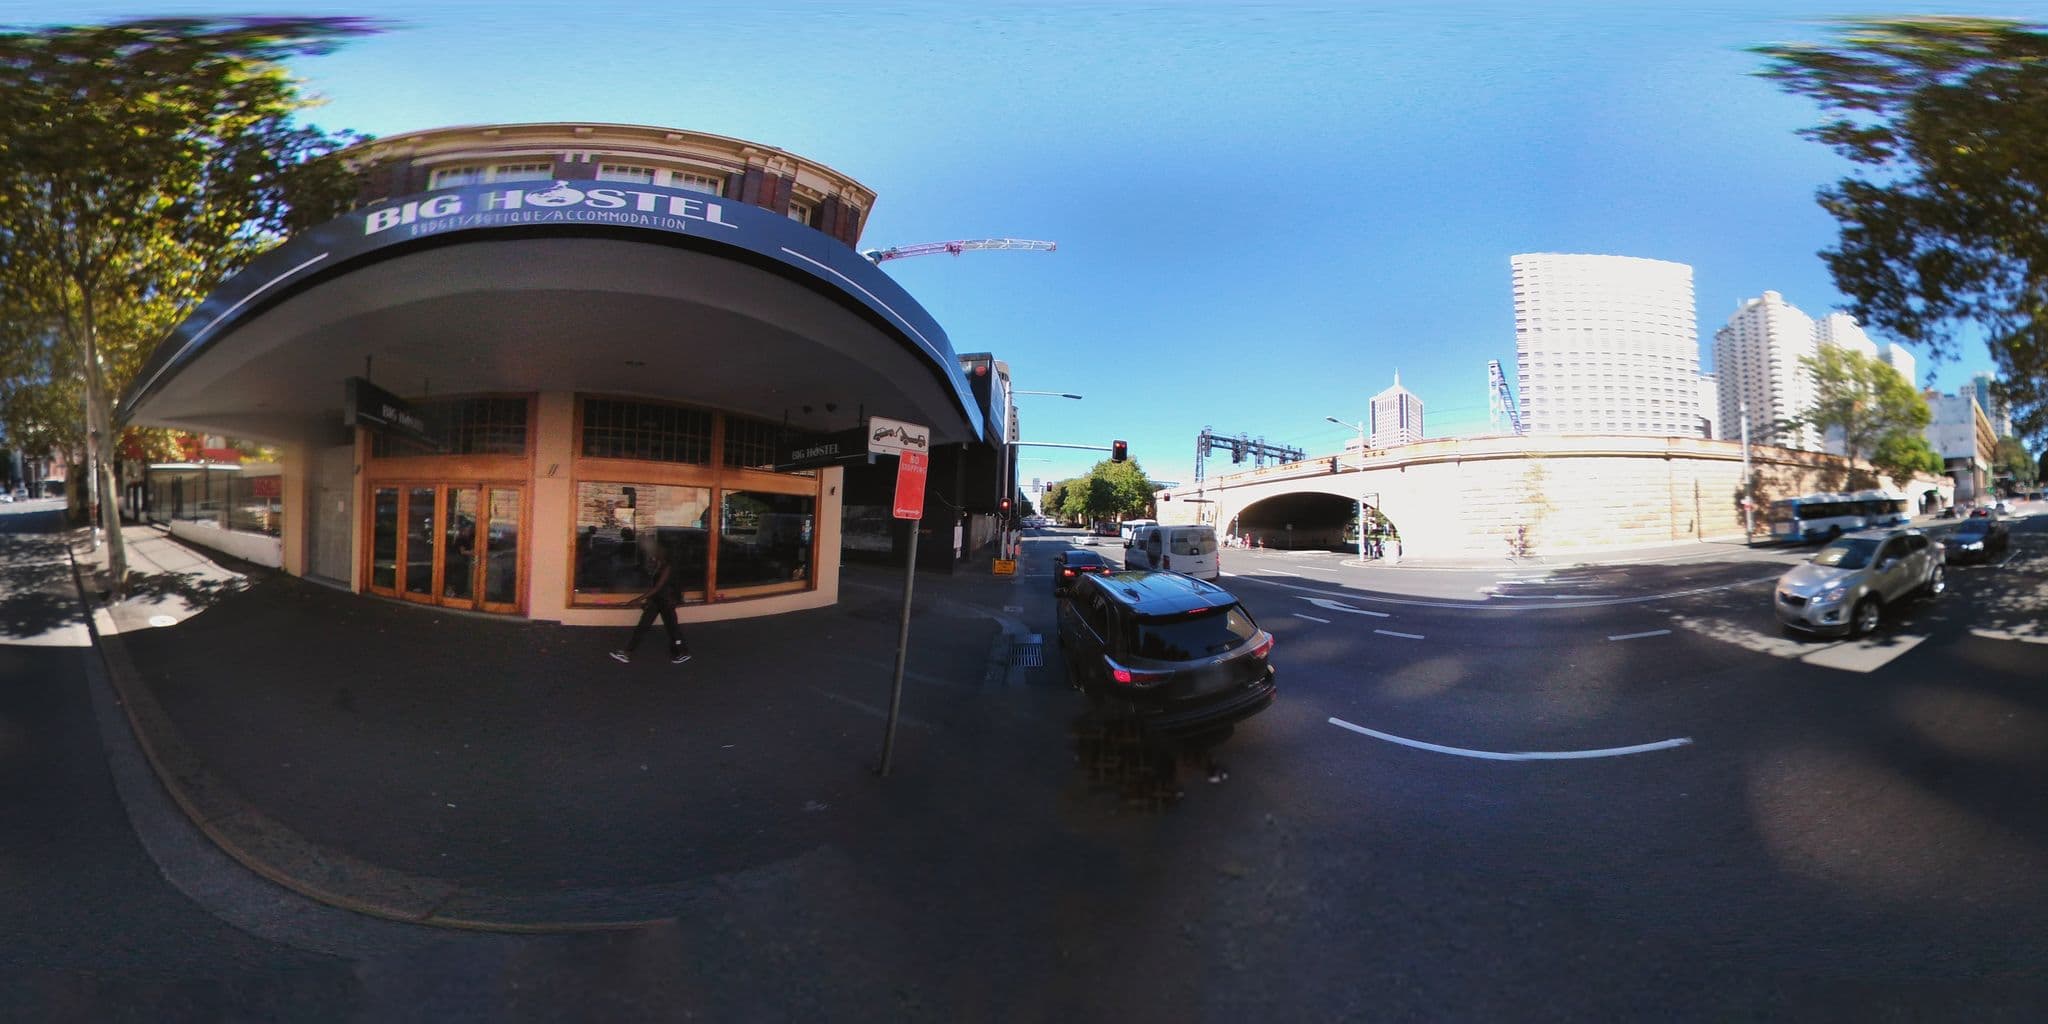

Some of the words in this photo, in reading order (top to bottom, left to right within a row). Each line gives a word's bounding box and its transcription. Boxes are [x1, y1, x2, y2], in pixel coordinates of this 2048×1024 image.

[365, 195, 461, 236] BIG
[484, 181, 739, 229] HOSTEL
[792, 449, 805, 460] BIG
[806, 443, 840, 457] HOSTEL
